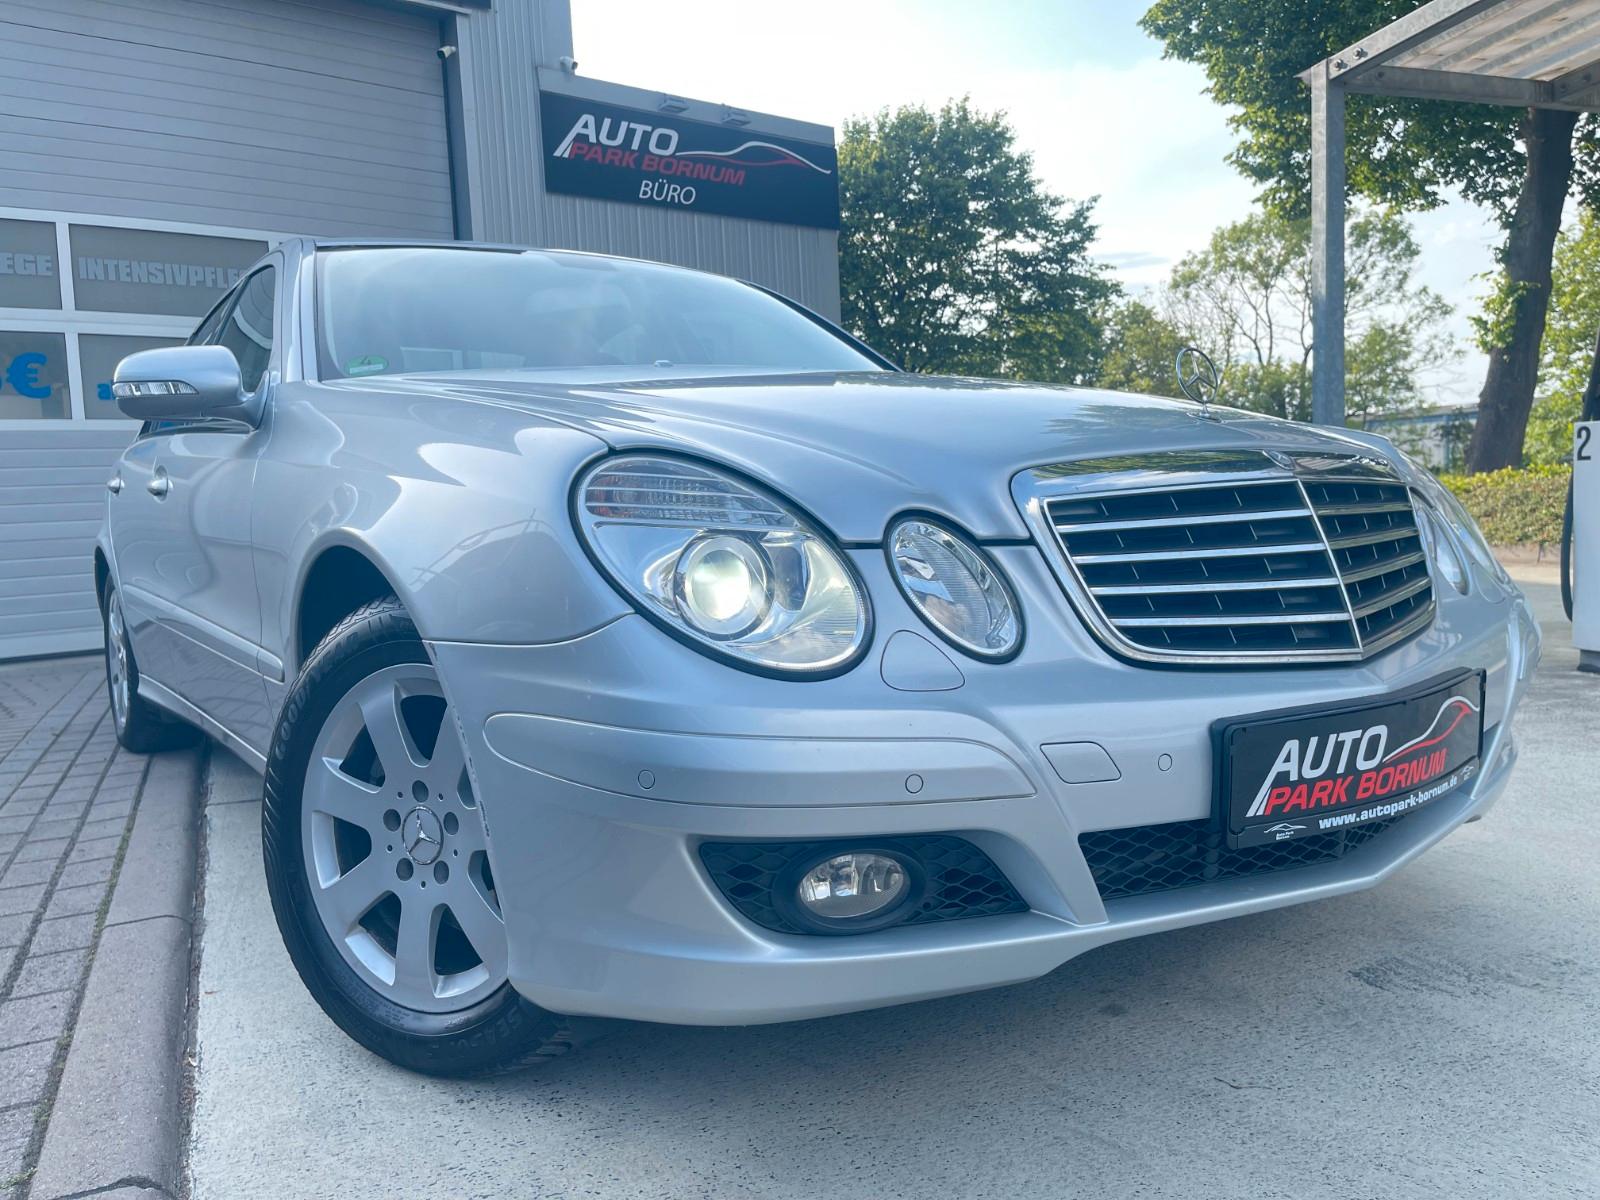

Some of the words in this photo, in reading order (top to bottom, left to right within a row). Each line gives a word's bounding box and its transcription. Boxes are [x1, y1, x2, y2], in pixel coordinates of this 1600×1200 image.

[553, 114, 679, 158] AUTO
[569, 142, 637, 168] PARK
[641, 156, 746, 186] BORNUM
[639, 178, 696, 205] BÜRO
[1576, 426, 1591, 461] 2
[1245, 724, 1388, 817] AUTO
[1264, 776, 1354, 816] PARK
[1356, 747, 1448, 800] BORNUM
[1319, 774, 1458, 829] www.autopark-bornum.de
